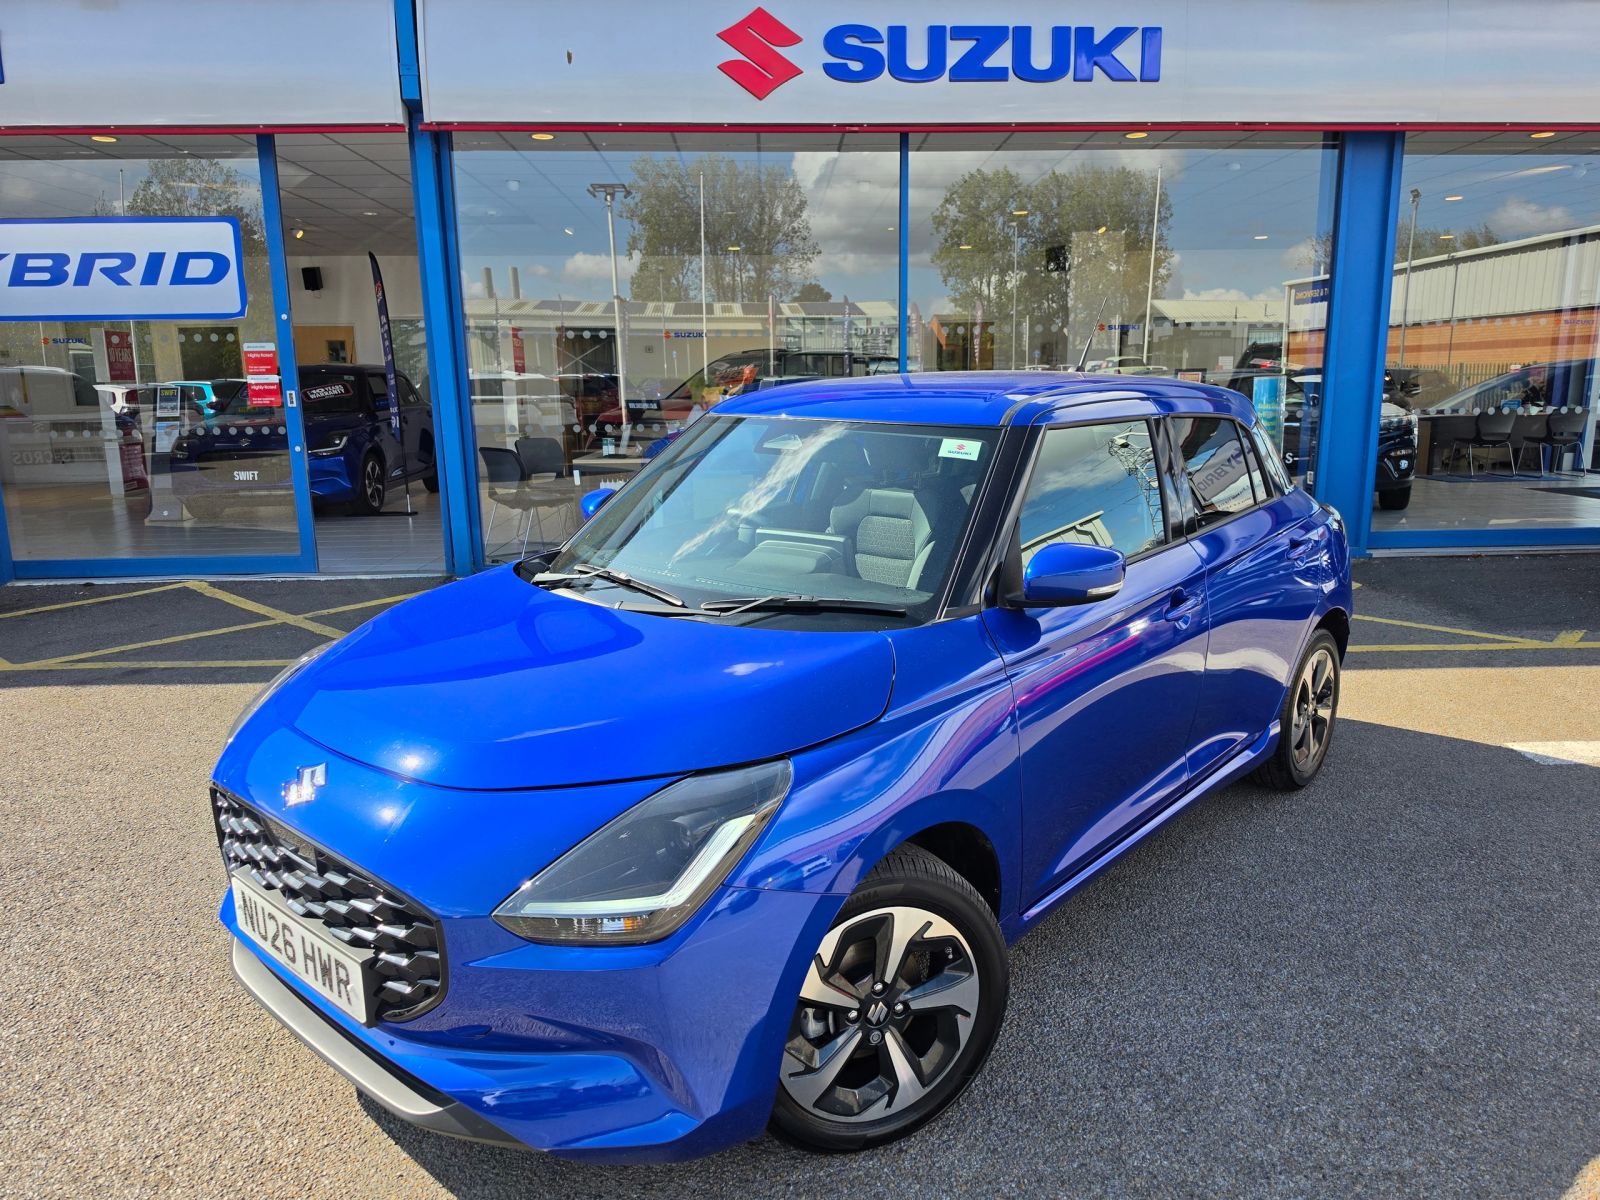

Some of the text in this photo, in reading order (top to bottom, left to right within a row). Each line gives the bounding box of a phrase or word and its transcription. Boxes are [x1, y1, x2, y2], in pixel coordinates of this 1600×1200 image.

[822, 23, 1163, 84] SUZUKI
[0, 251, 231, 287] BRID
[233, 470, 259, 481] SWIFT
[240, 890, 354, 1006] NU26 HWR
